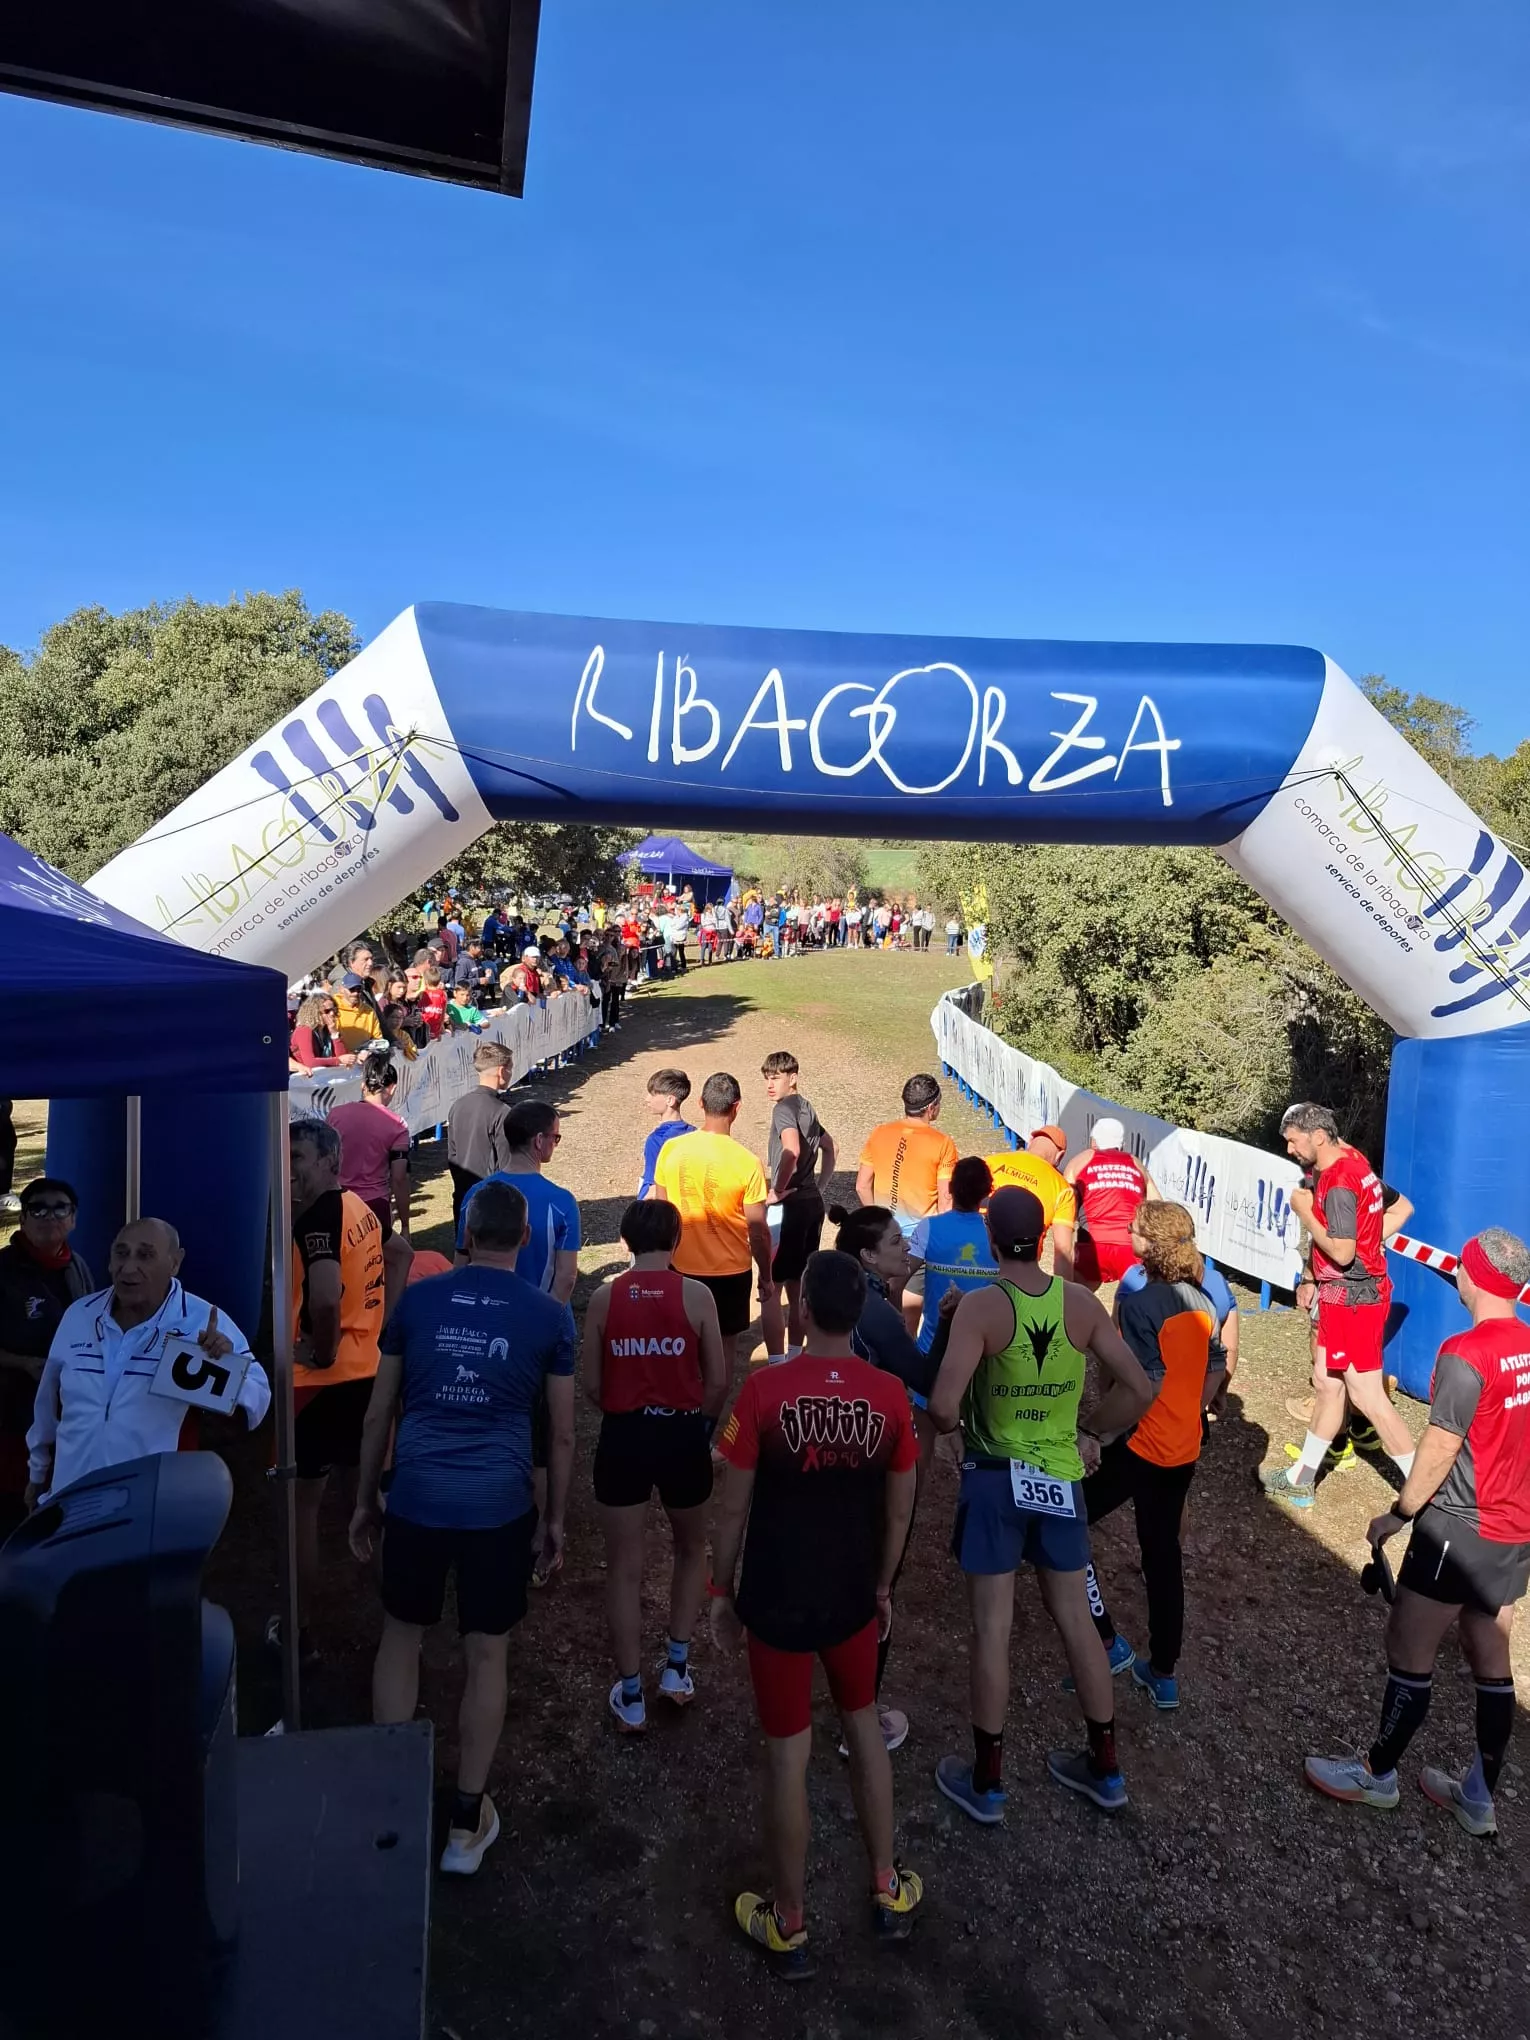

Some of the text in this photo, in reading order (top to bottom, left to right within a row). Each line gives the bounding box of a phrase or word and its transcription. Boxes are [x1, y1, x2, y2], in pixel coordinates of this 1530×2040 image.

[572, 645, 1182, 806] RIBAGORZA
[1294, 797, 1348, 854] comarca
[1346, 852, 1364, 872] de
[1362, 870, 1378, 886] la
[276, 845, 380, 931] servicio de deportes
[1325, 862, 1414, 953] servicio de deportes
[208, 912, 265, 957] omarca
[264, 894, 285, 915] de
[285, 886, 301, 900] la
[993, 1163, 1038, 1187] ALMUNIA
[172, 1351, 231, 1397] 5
[435, 1393, 491, 1404] PIRINEOS
[442, 1384, 486, 1396] BODEGA
[1020, 1479, 1065, 1507] 356
